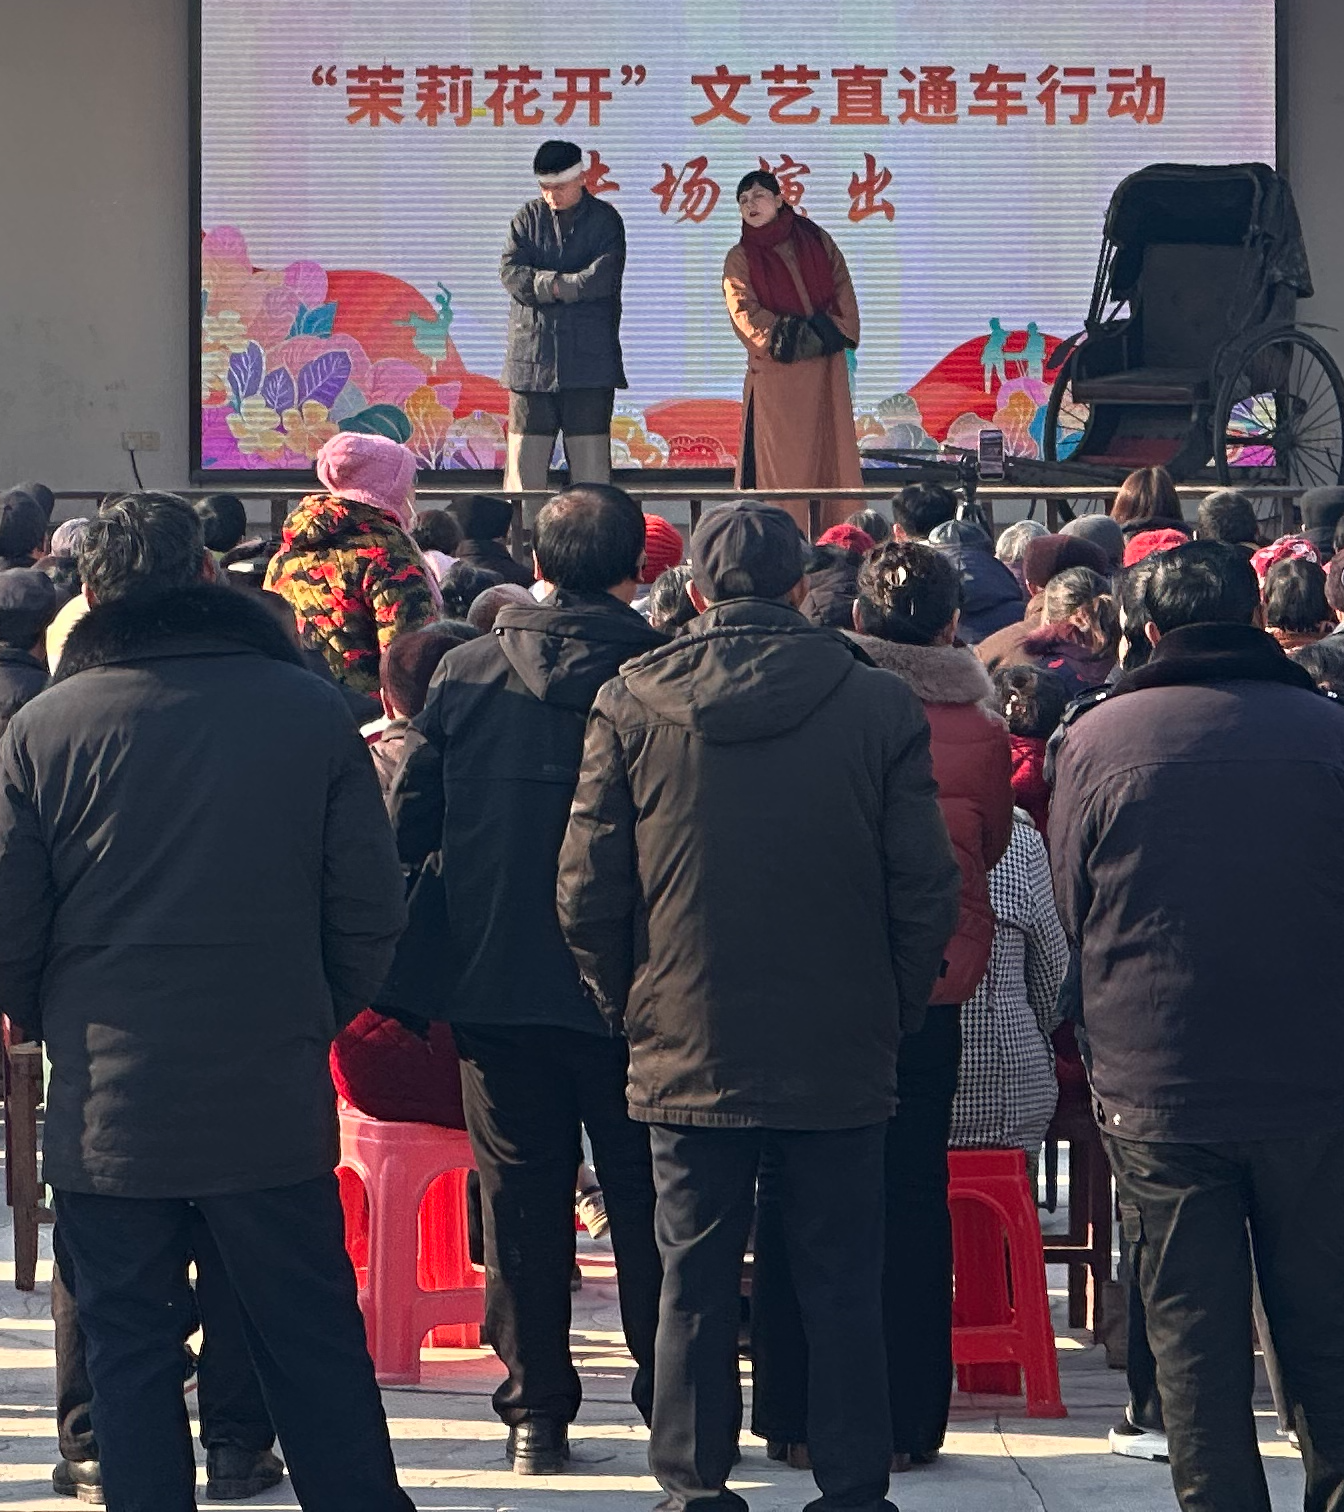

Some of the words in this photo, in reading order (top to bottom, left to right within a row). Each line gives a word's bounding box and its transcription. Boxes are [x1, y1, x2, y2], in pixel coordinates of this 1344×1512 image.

[691, 64, 1166, 126] 文艺直通车行动
